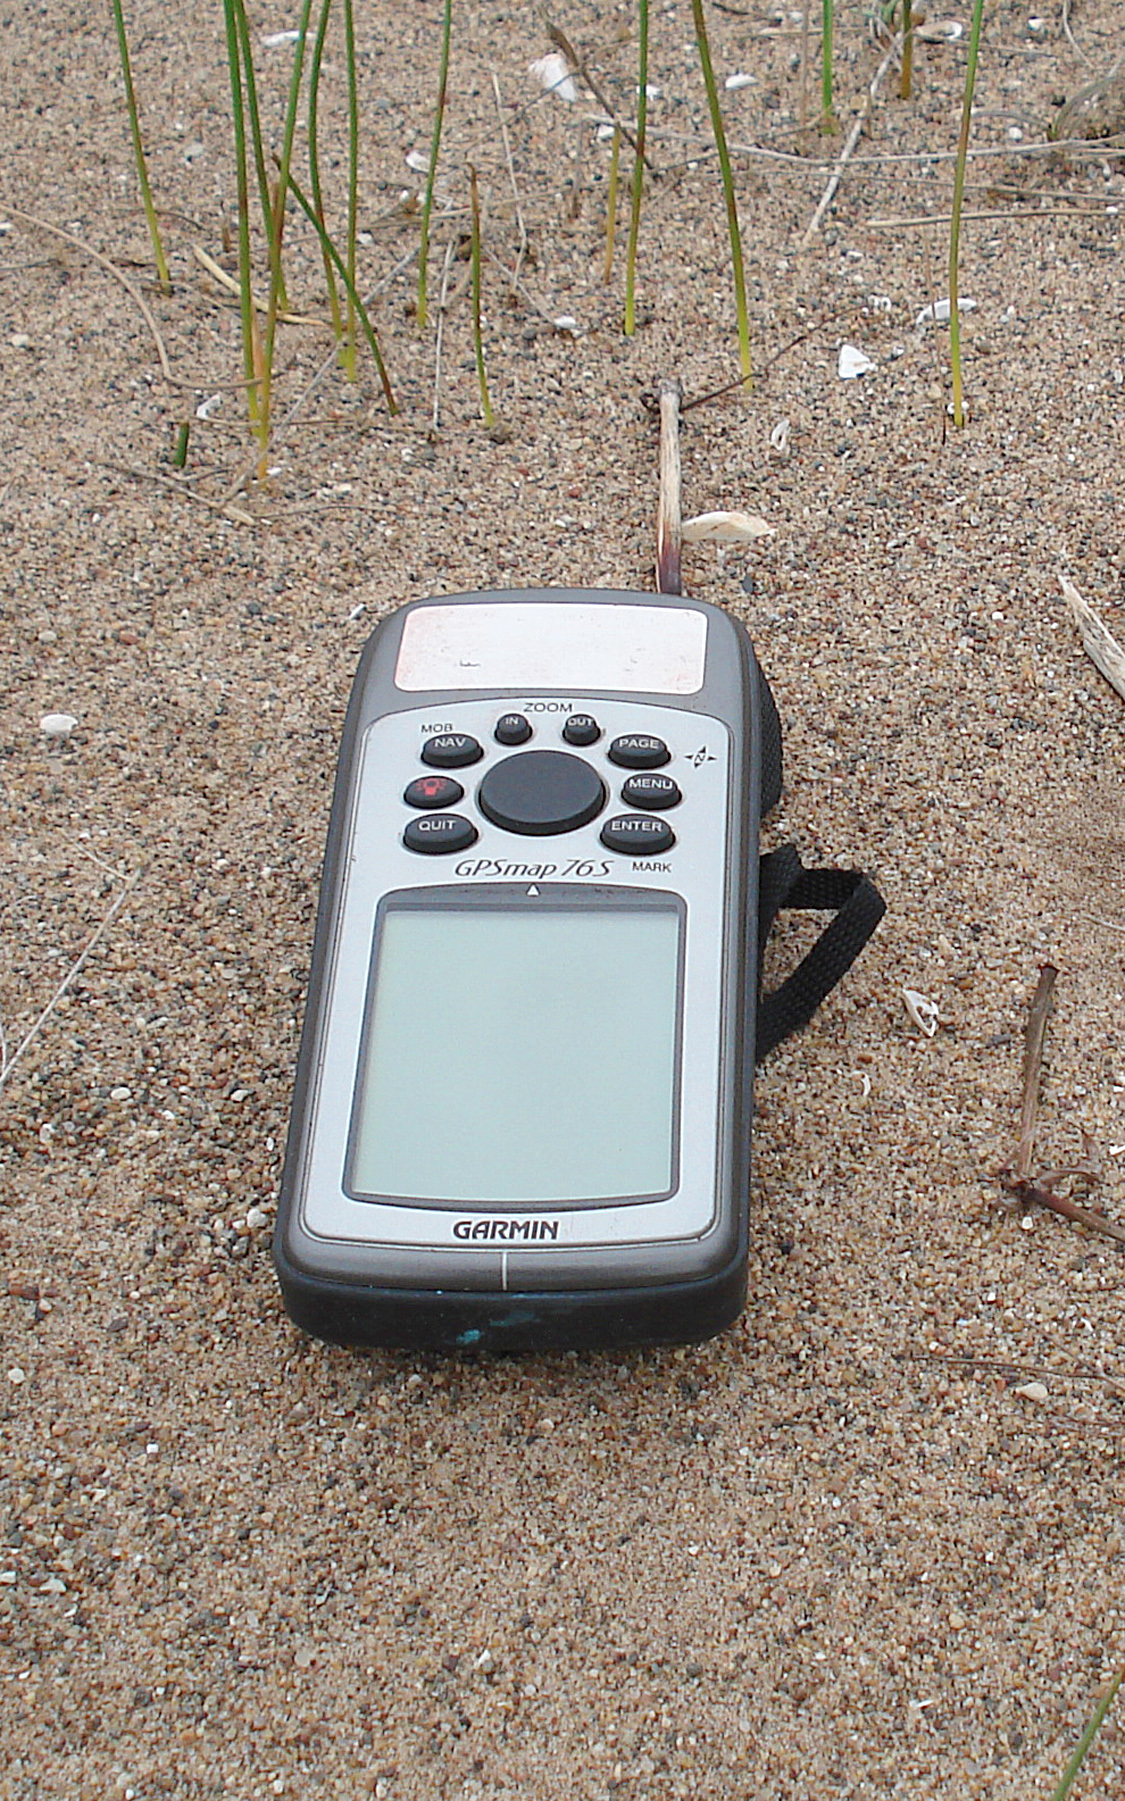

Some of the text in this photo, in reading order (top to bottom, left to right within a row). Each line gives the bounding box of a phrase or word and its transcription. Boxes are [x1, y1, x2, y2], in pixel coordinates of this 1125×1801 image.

[523, 702, 573, 713] ZOOM
[505, 716, 518, 725] IN
[421, 723, 453, 733] MOB
[434, 737, 466, 748] NAV
[619, 738, 660, 750] PAGE
[628, 778, 674, 790] MENU
[418, 820, 456, 832] QUIT
[611, 820, 663, 832] ENTER
[454, 859, 614, 879] GPSmap 76S
[632, 861, 672, 873] MARK
[453, 1220, 559, 1240] GARMIN
